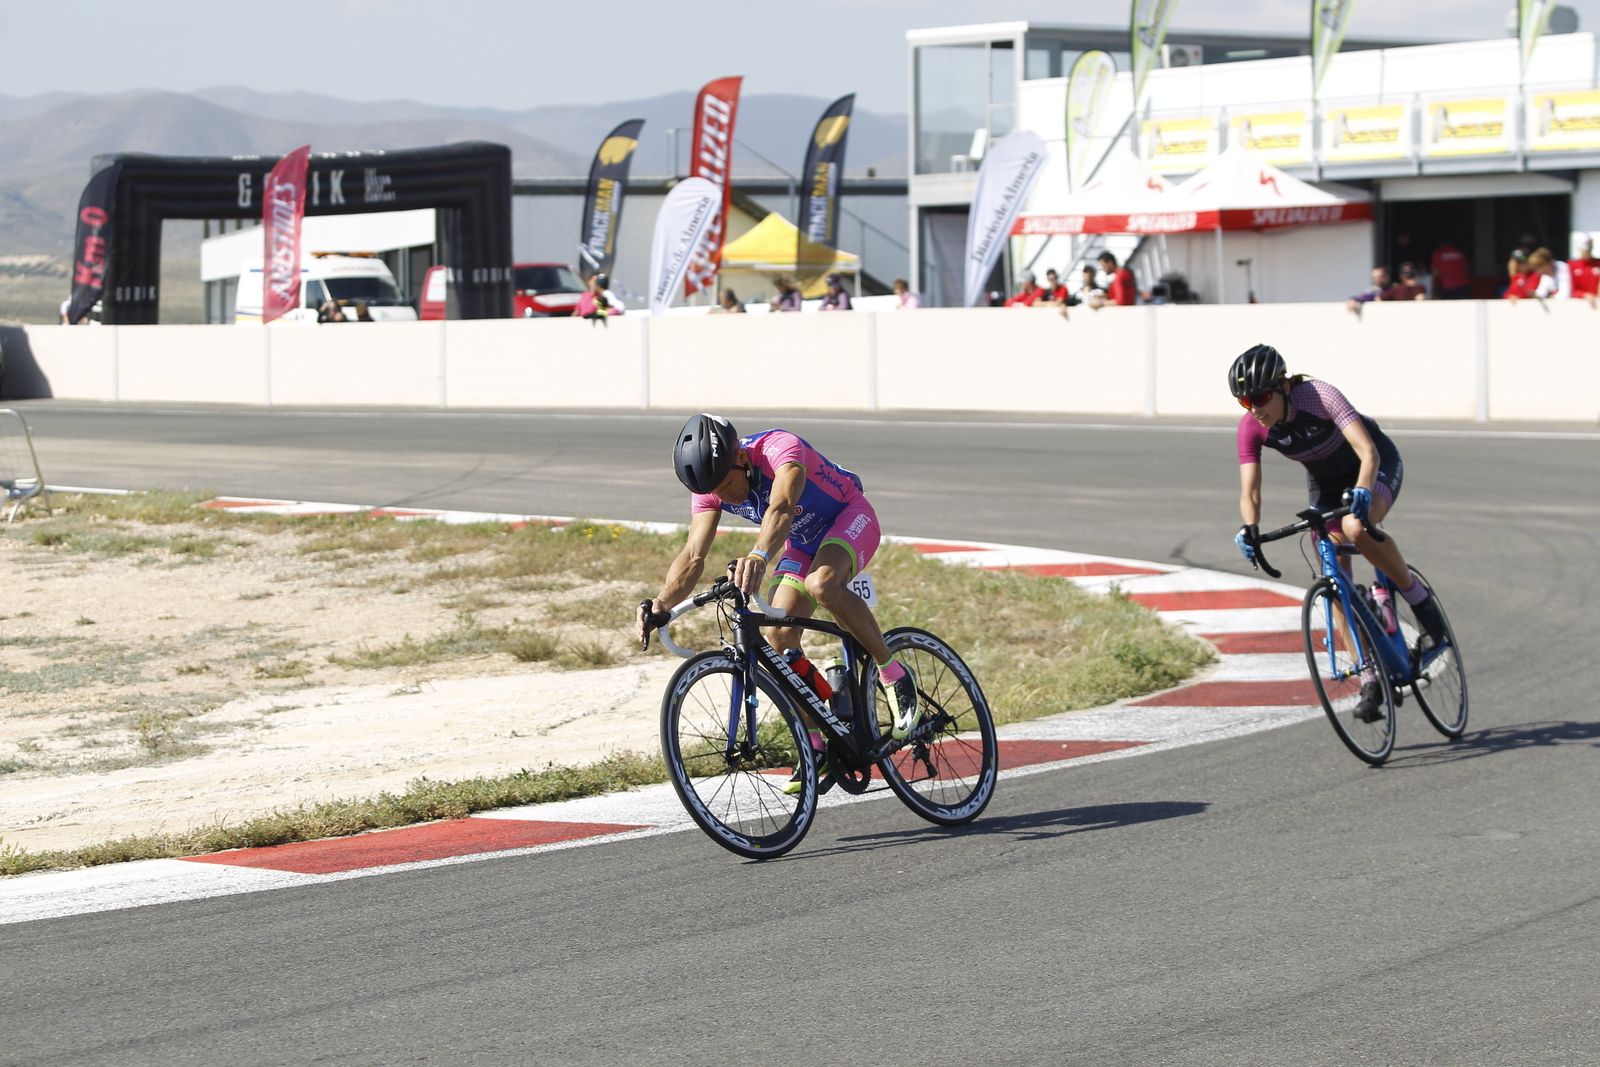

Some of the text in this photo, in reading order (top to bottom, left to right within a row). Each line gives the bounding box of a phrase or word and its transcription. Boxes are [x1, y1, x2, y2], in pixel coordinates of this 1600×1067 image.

[237, 170, 346, 208] GIK
[808, 162, 830, 243] TRACKMAN
[588, 178, 615, 259] TRACKMAN
[994, 203, 1008, 221] de
[710, 430, 719, 457] MET
[853, 580, 871, 600] 55
